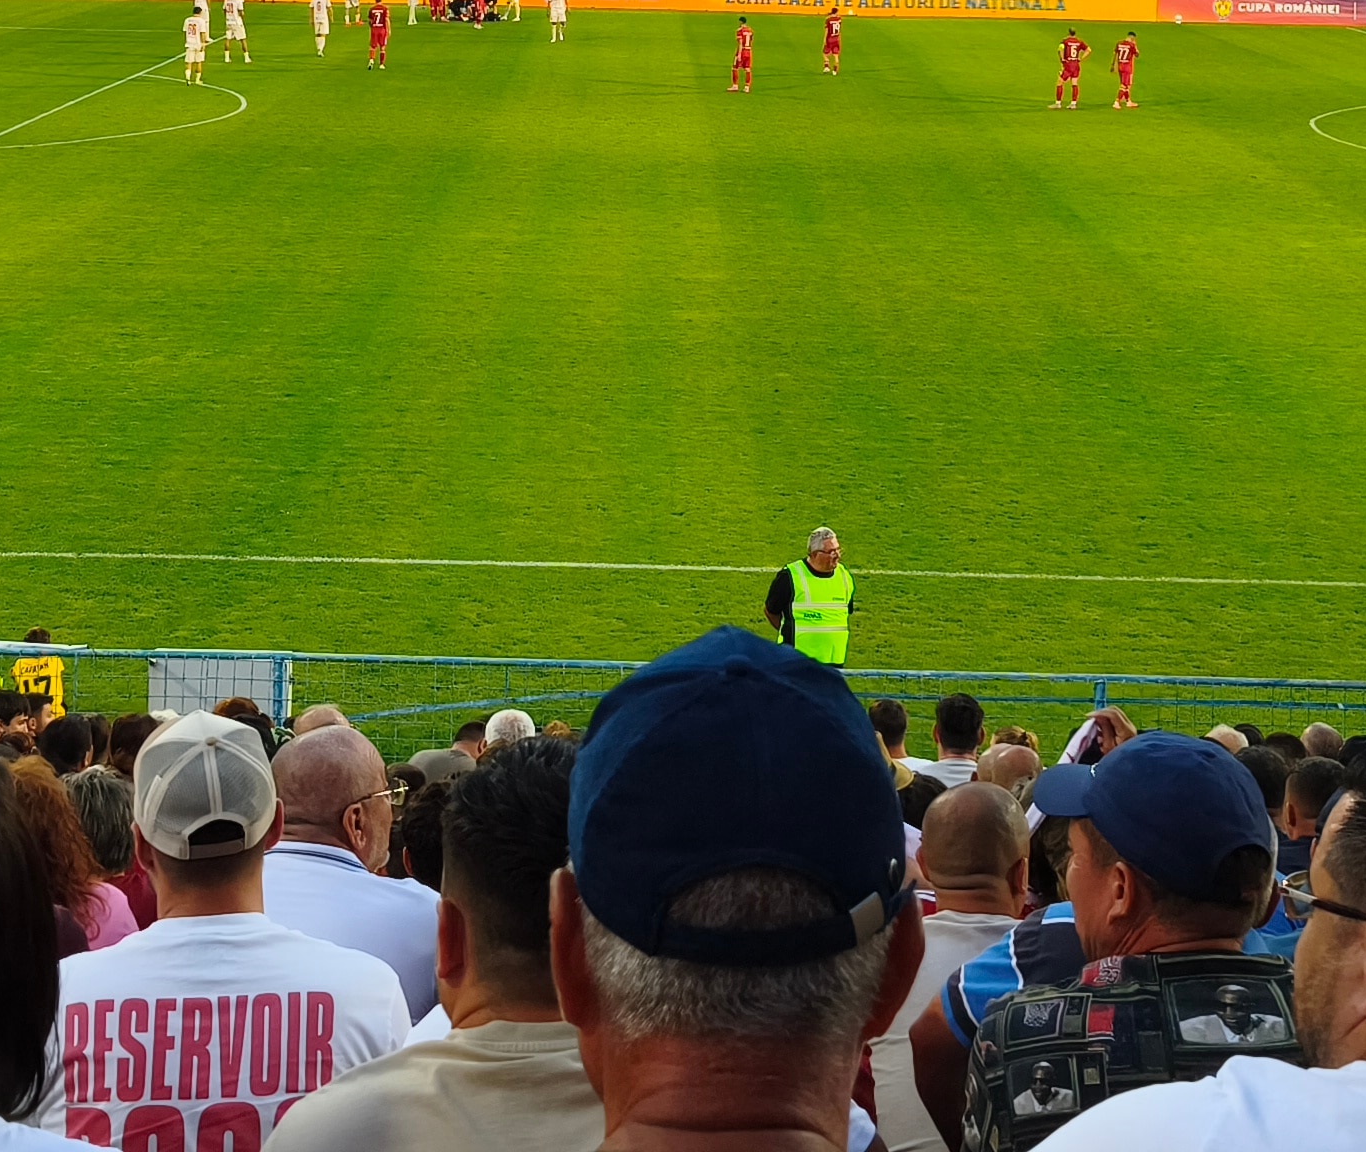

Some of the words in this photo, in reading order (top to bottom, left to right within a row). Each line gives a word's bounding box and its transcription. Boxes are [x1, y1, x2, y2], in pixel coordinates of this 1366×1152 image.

[1237, 2, 1272, 13] CUPA
[1274, 0, 1340, 15] ROMÂNIEI
[1118, 47, 1130, 60] 77
[23, 675, 51, 695] 17
[63, 991, 335, 1103] RESERVOIR
